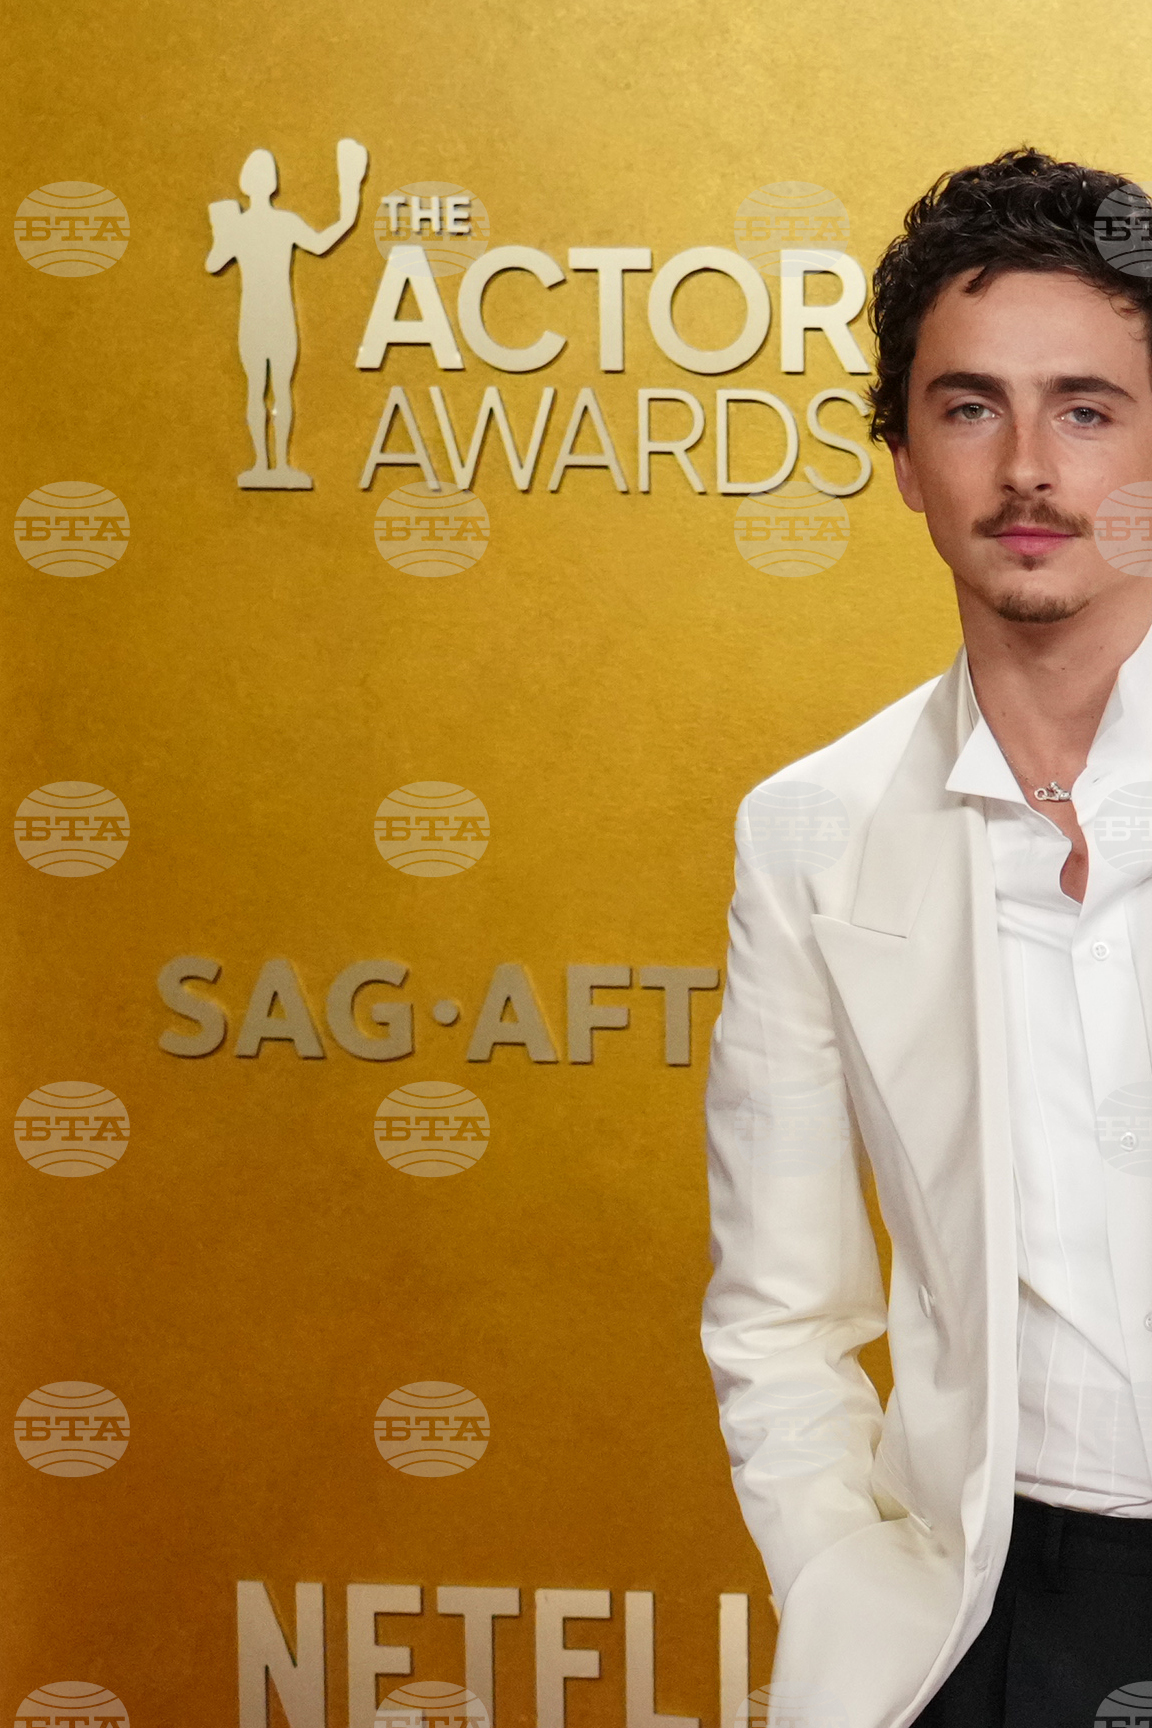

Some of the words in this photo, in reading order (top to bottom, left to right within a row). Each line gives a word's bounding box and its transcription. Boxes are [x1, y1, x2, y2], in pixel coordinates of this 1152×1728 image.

[381, 196, 470, 233] THE
[355, 245, 870, 373] ACTOR
[360, 386, 872, 497] AWARDS
